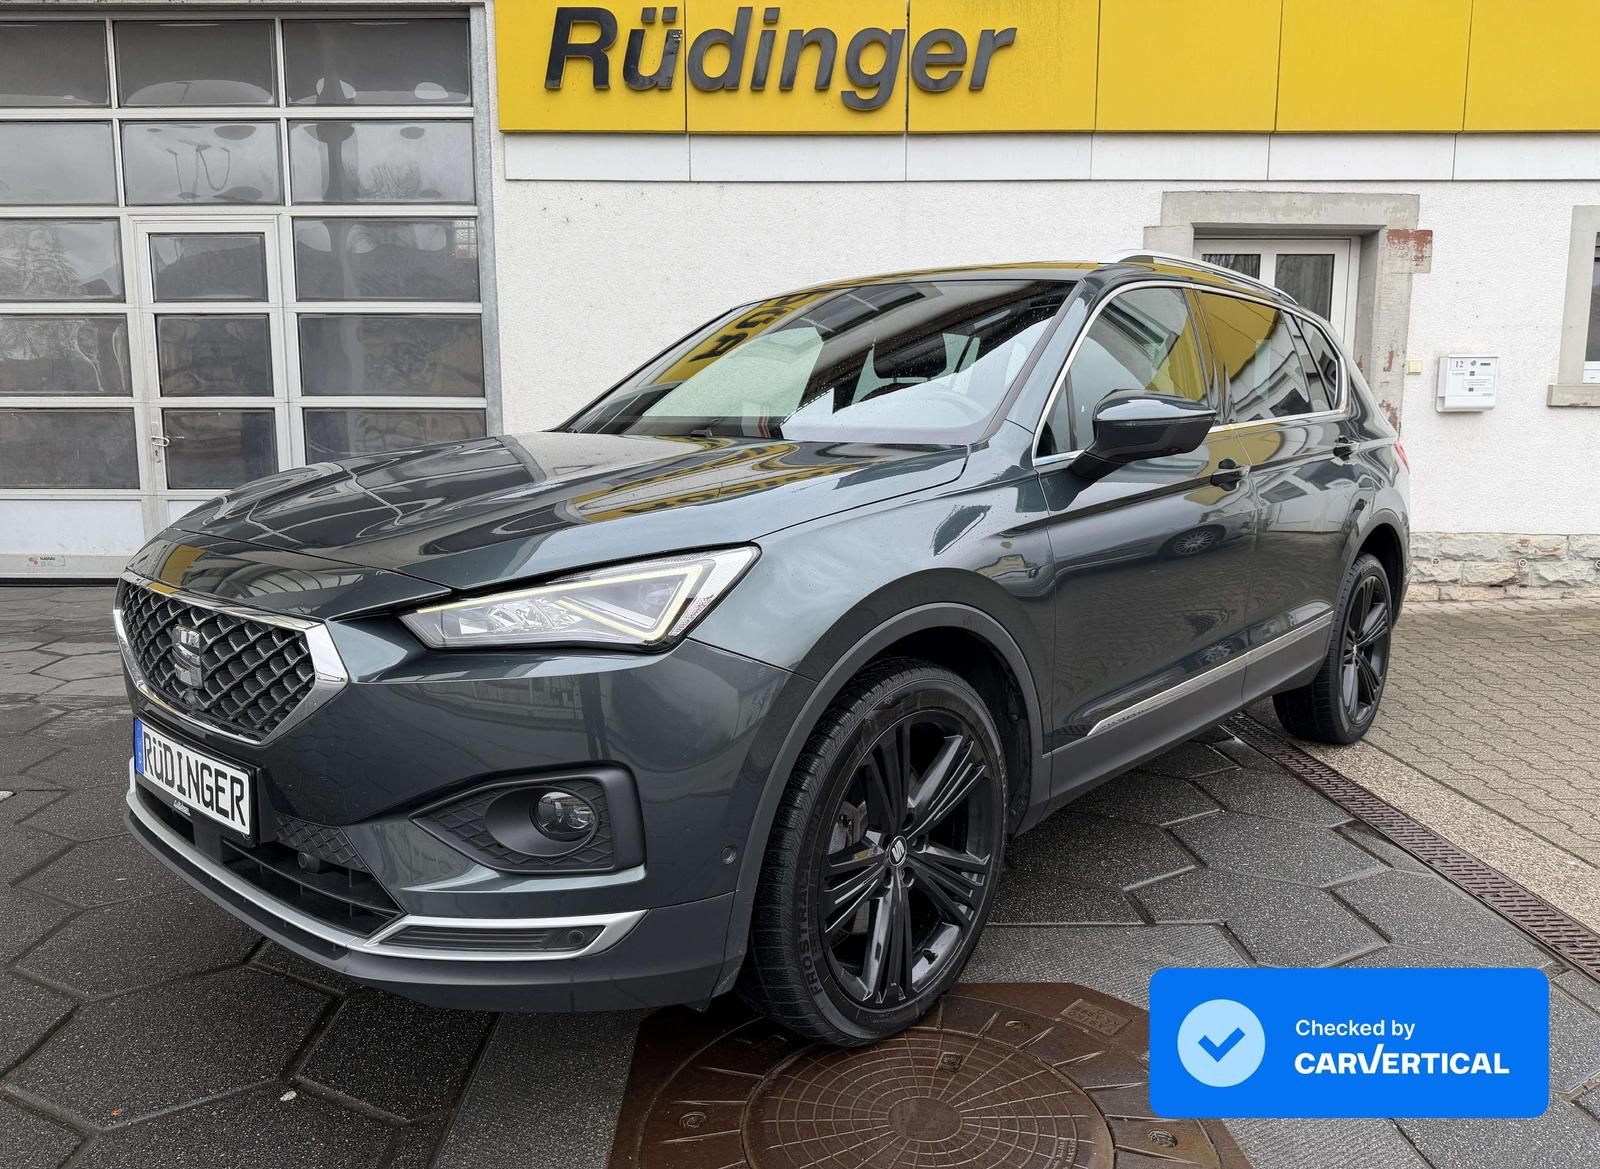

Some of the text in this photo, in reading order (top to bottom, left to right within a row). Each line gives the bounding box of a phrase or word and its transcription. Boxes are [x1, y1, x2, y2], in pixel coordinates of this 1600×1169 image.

[544, 6, 1018, 111] Rüdinger
[1455, 360, 1464, 368] 12
[143, 731, 246, 826] RÜDINGER
